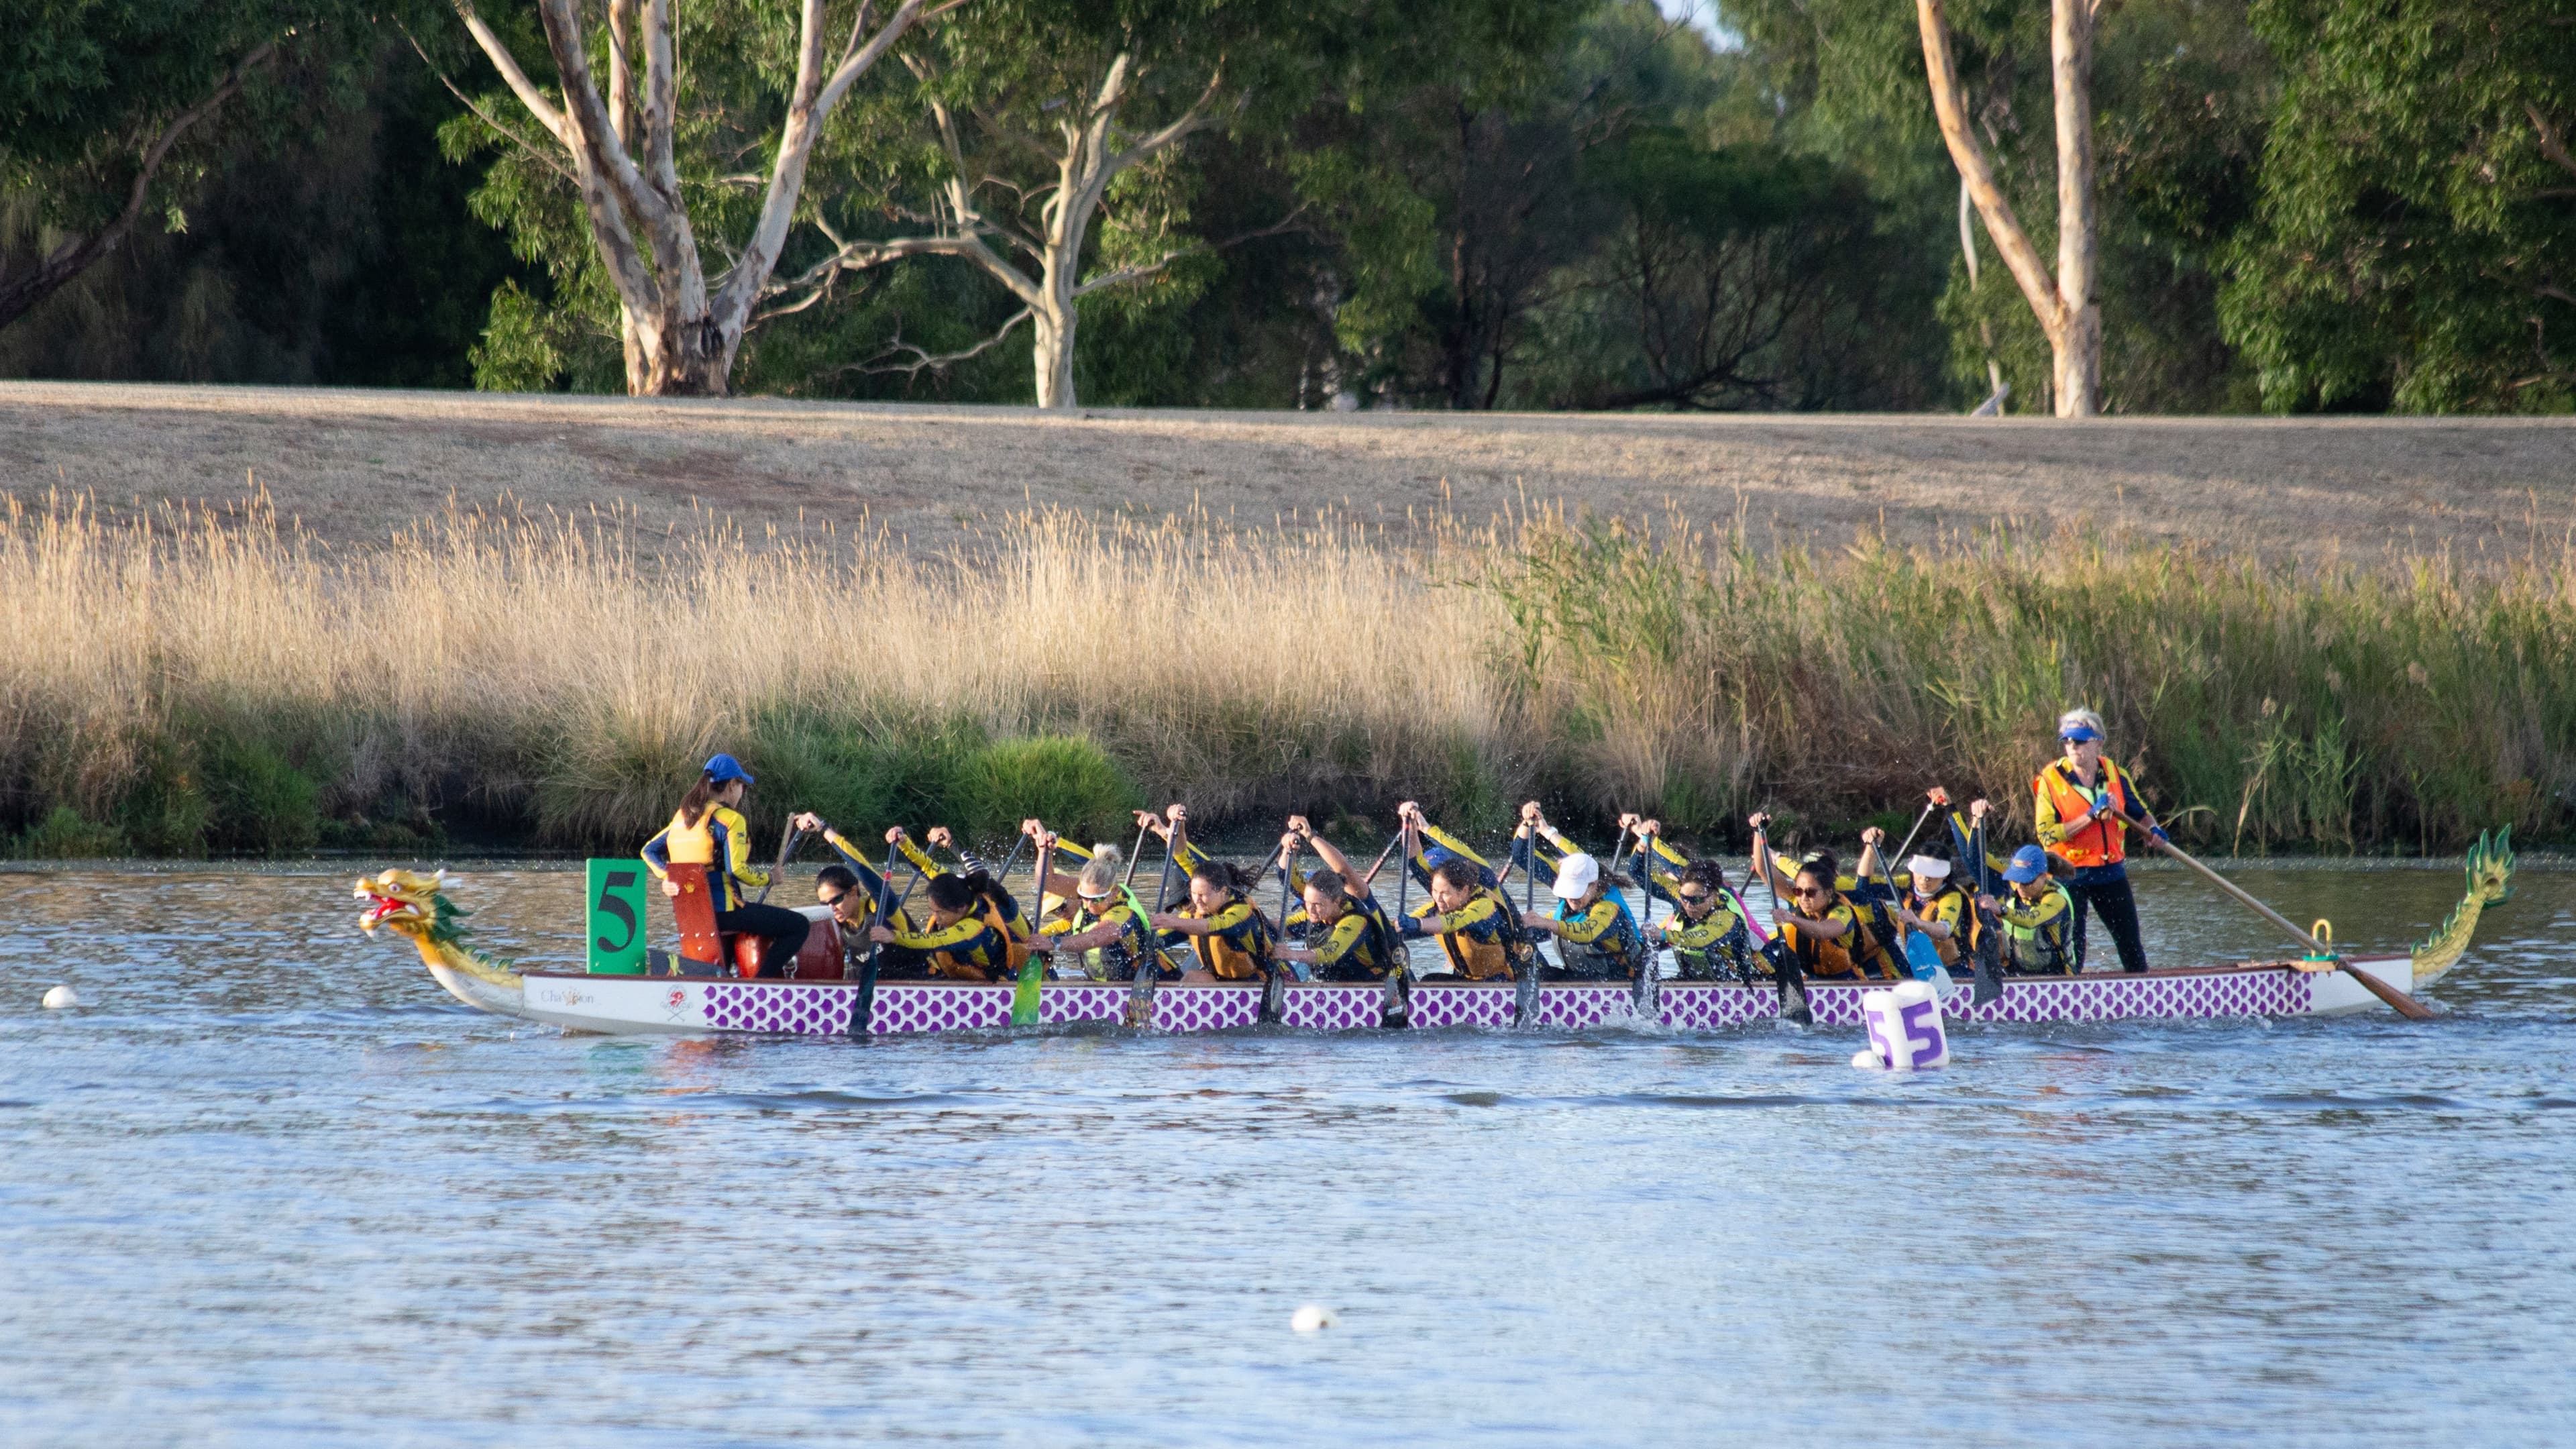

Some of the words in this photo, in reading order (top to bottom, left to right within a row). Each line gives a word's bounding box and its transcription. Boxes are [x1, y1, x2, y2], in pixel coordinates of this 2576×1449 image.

[596, 871, 637, 954] 5
[1866, 1010, 1894, 1070] 5
[1900, 999, 1943, 1068] 5
